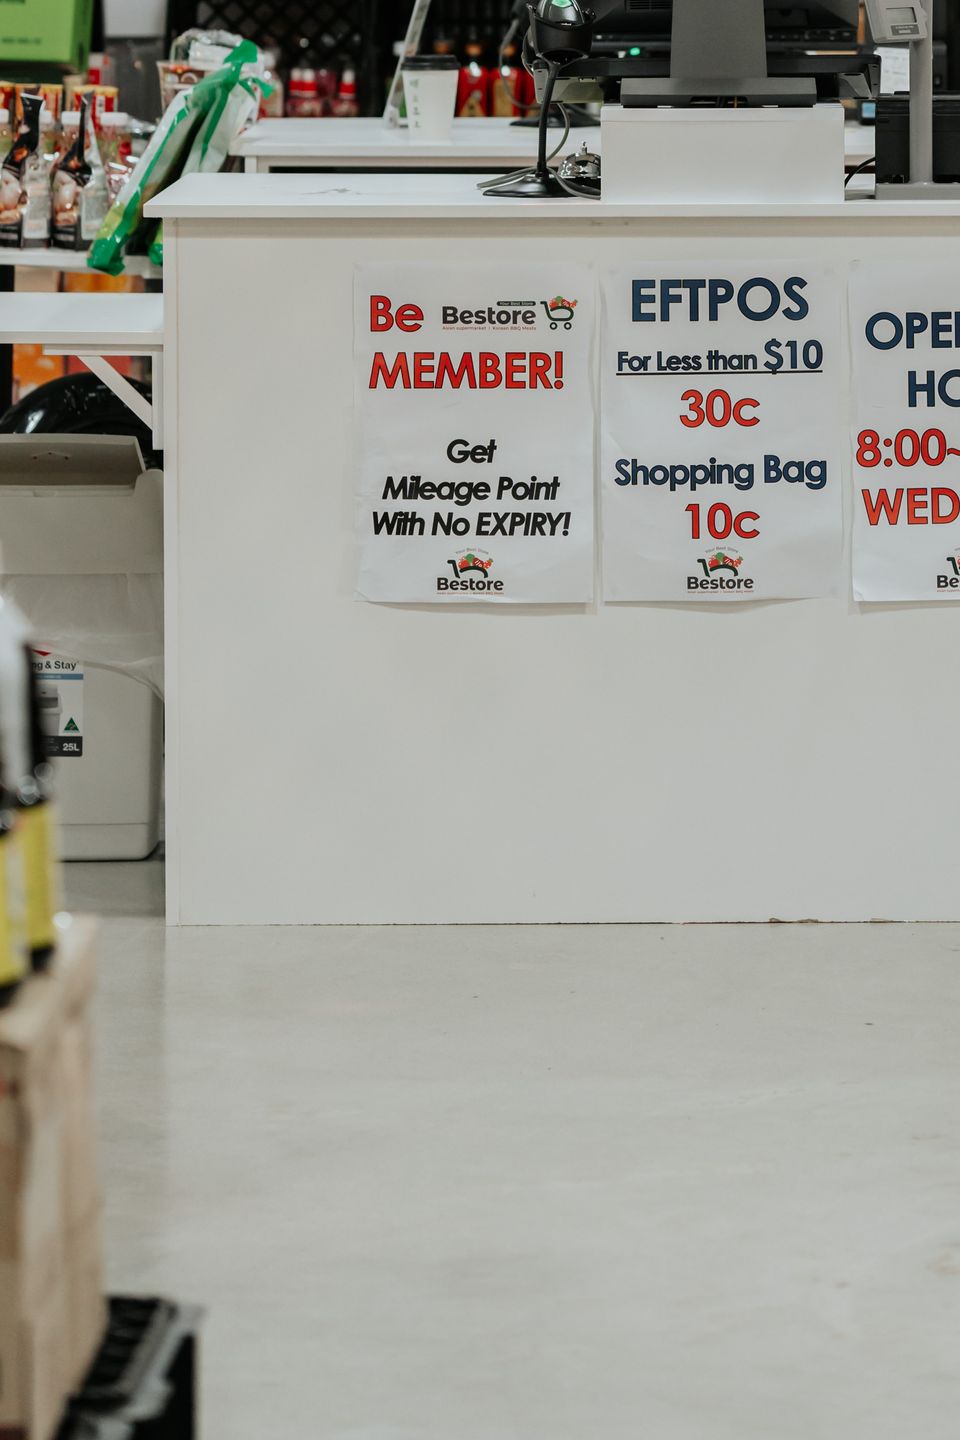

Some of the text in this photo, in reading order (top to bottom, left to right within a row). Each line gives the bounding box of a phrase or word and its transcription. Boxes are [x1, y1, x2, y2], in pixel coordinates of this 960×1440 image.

[370, 295, 424, 333] Be
[442, 306, 536, 325] Bestore
[632, 276, 809, 322] EFTPOS
[368, 351, 564, 390] MEMBER!
[617, 338, 823, 375] For Less than $10
[679, 389, 760, 428] 30c
[447, 438, 497, 464] Get
[614, 454, 827, 491] Shopping Bag
[382, 475, 560, 506] Mileage Point
[372, 511, 571, 537] With No EXPIRY!
[684, 502, 760, 539] 10c
[437, 577, 504, 591] Bestore
[687, 576, 754, 589] Bestore
[62, 742, 80, 751] 25L
